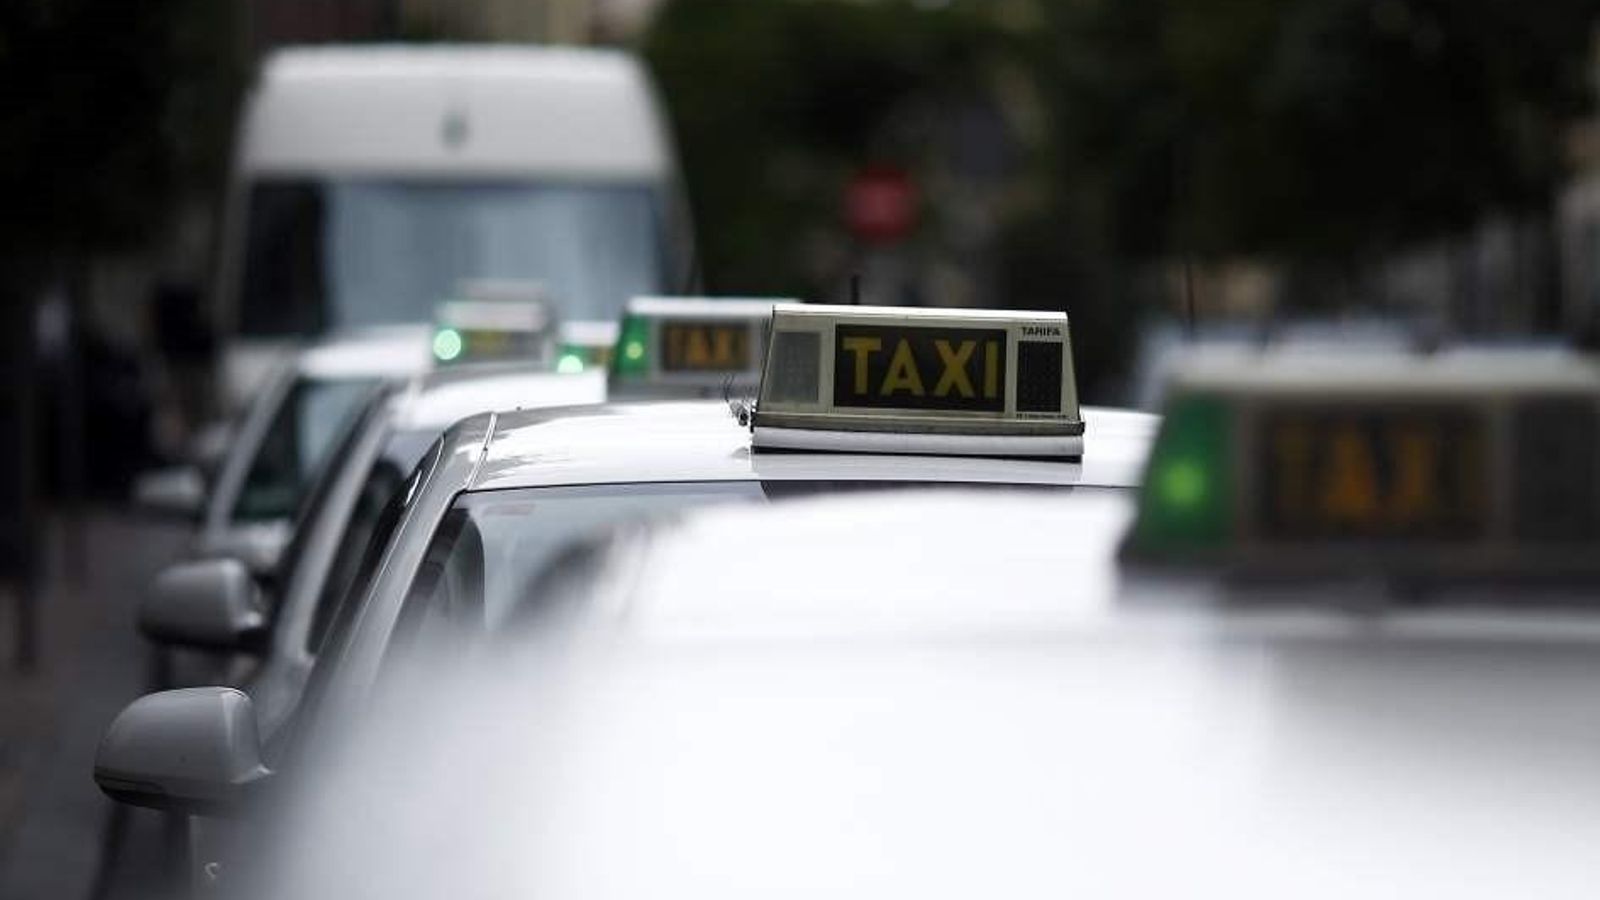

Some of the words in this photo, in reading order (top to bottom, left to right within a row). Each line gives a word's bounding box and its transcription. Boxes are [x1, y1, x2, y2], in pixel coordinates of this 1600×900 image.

[668, 324, 748, 367] TAXI
[1021, 326, 1061, 336] TARIFA
[843, 336, 999, 398] TAXI
